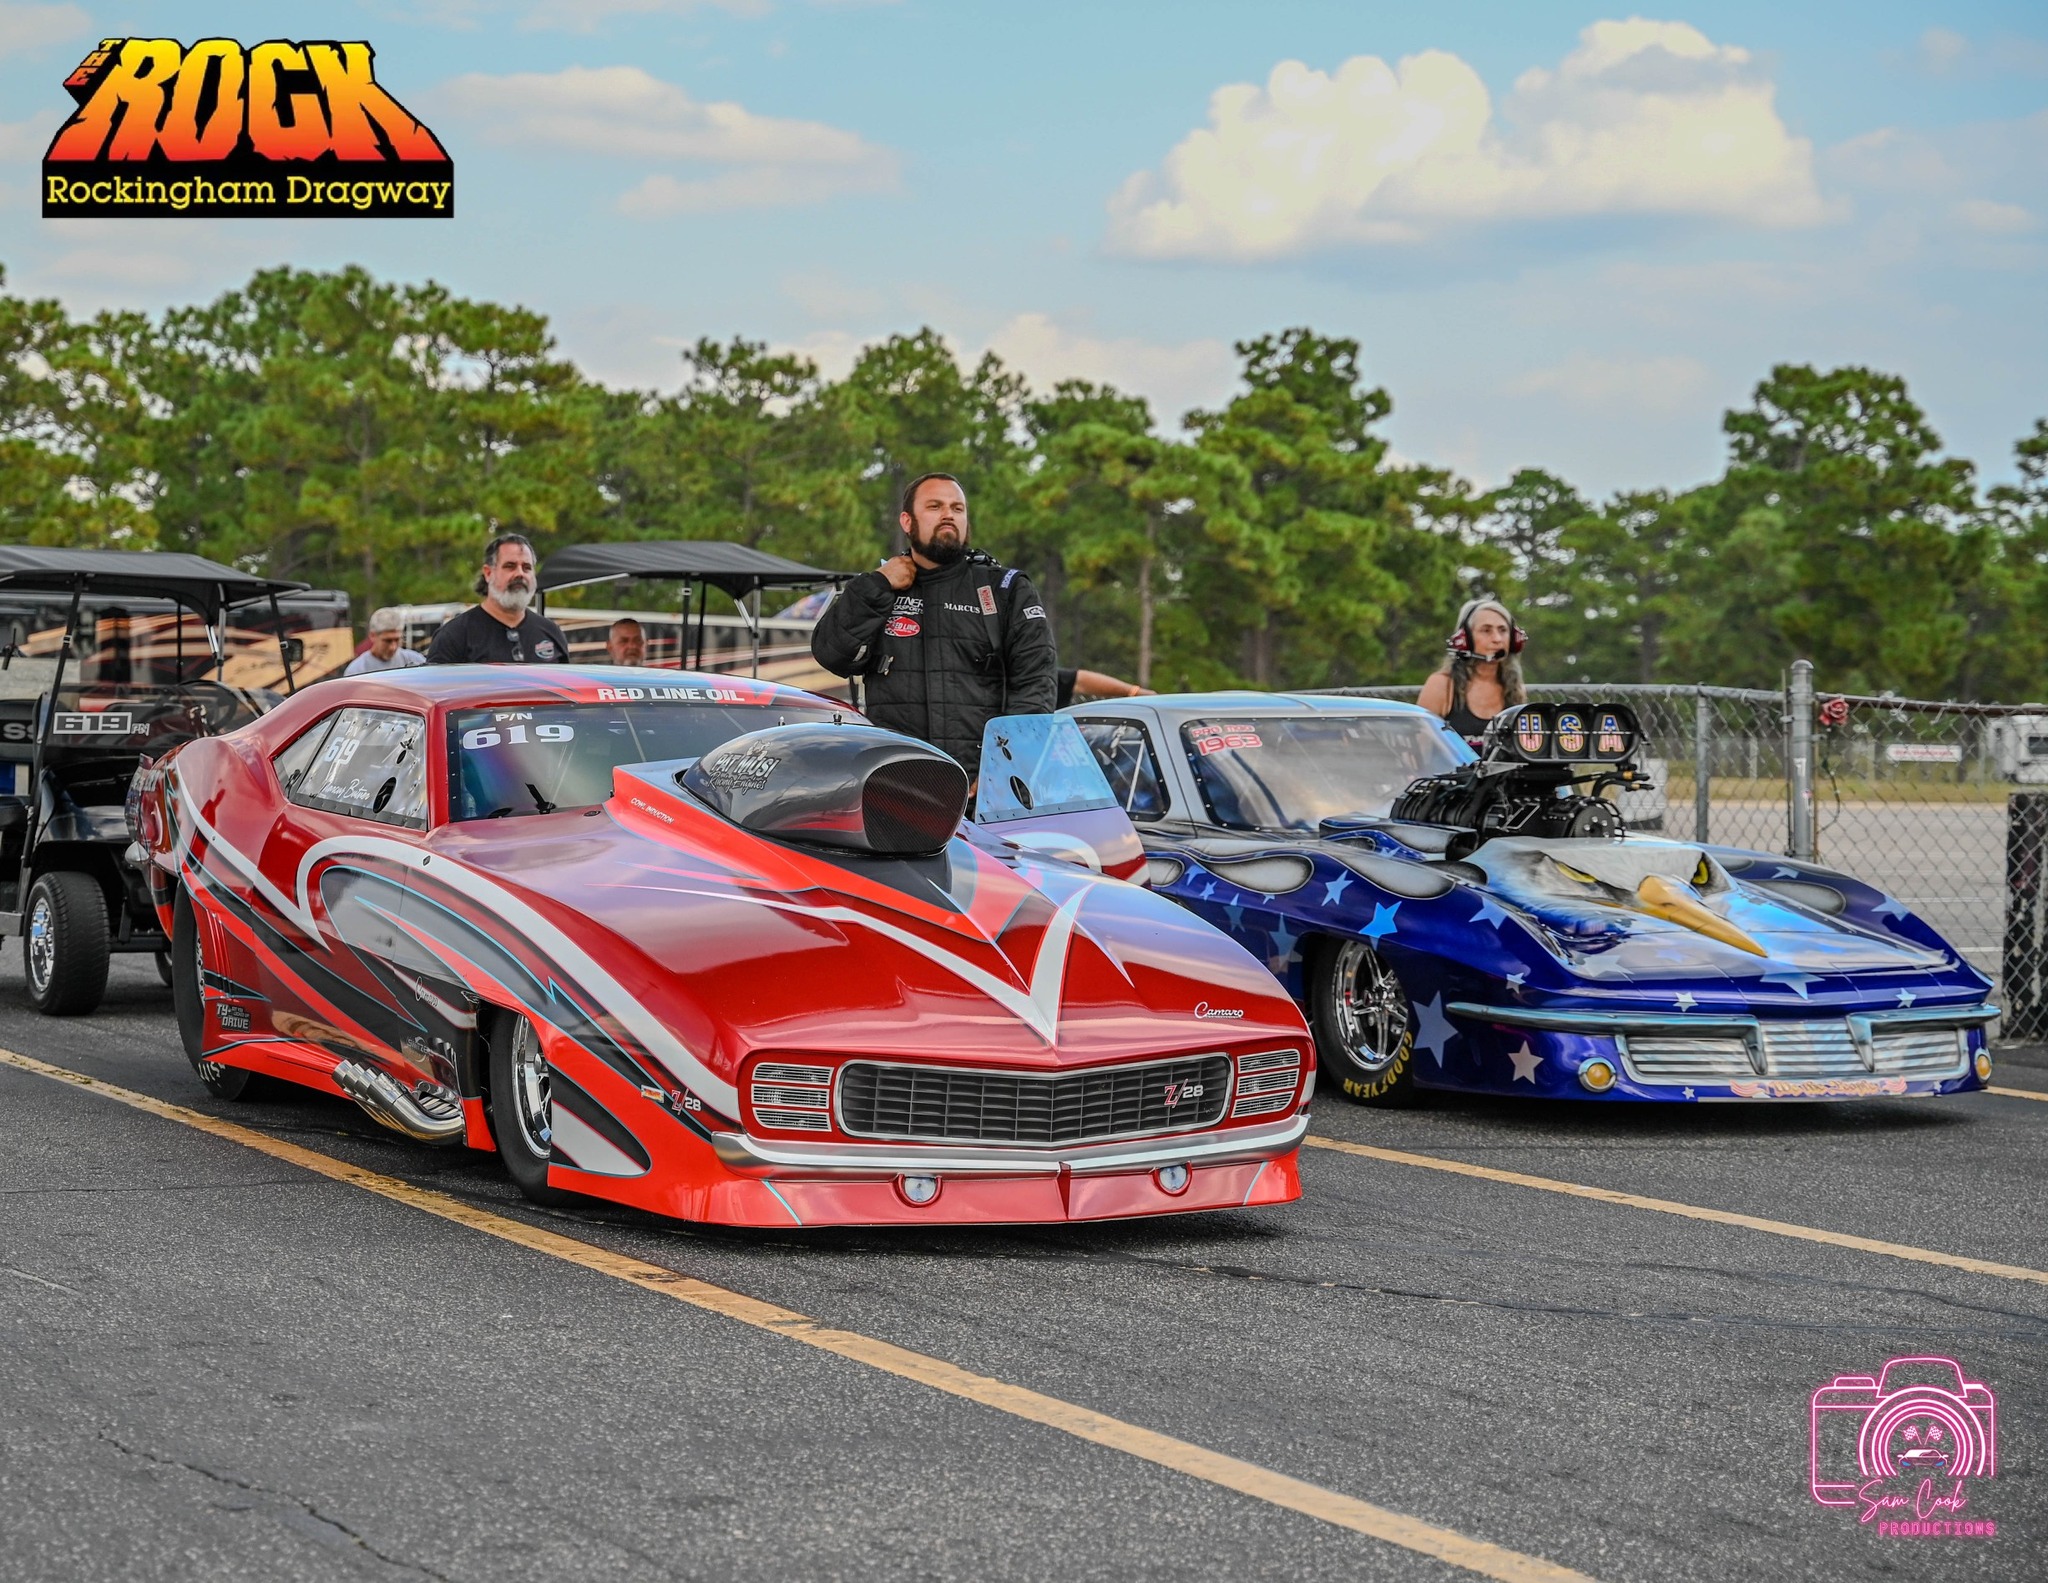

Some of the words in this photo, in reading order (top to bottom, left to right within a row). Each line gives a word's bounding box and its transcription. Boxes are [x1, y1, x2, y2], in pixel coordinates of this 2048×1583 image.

[943, 602, 981, 614] MARCUS
[598, 688, 649, 702] RED
[706, 688, 745, 702] OIL
[56, 715, 129, 732] 619
[495, 712, 533, 722] P/N
[462, 724, 575, 751] 619
[1517, 713, 1625, 752] USA
[324, 737, 360, 765] 619
[1197, 734, 1262, 756] 1963
[711, 753, 741, 773] PAT
[733, 755, 781, 778] MUSI
[732, 774, 767, 795] Engines
[630, 797, 647, 810] COWL
[645, 805, 675, 825] INDUCTION
[1194, 1001, 1244, 1019] Camaro
[222, 1016, 249, 1030] DRIVE
[671, 1088, 702, 1115] Z/28
[1164, 1079, 1204, 1109] Z/28
